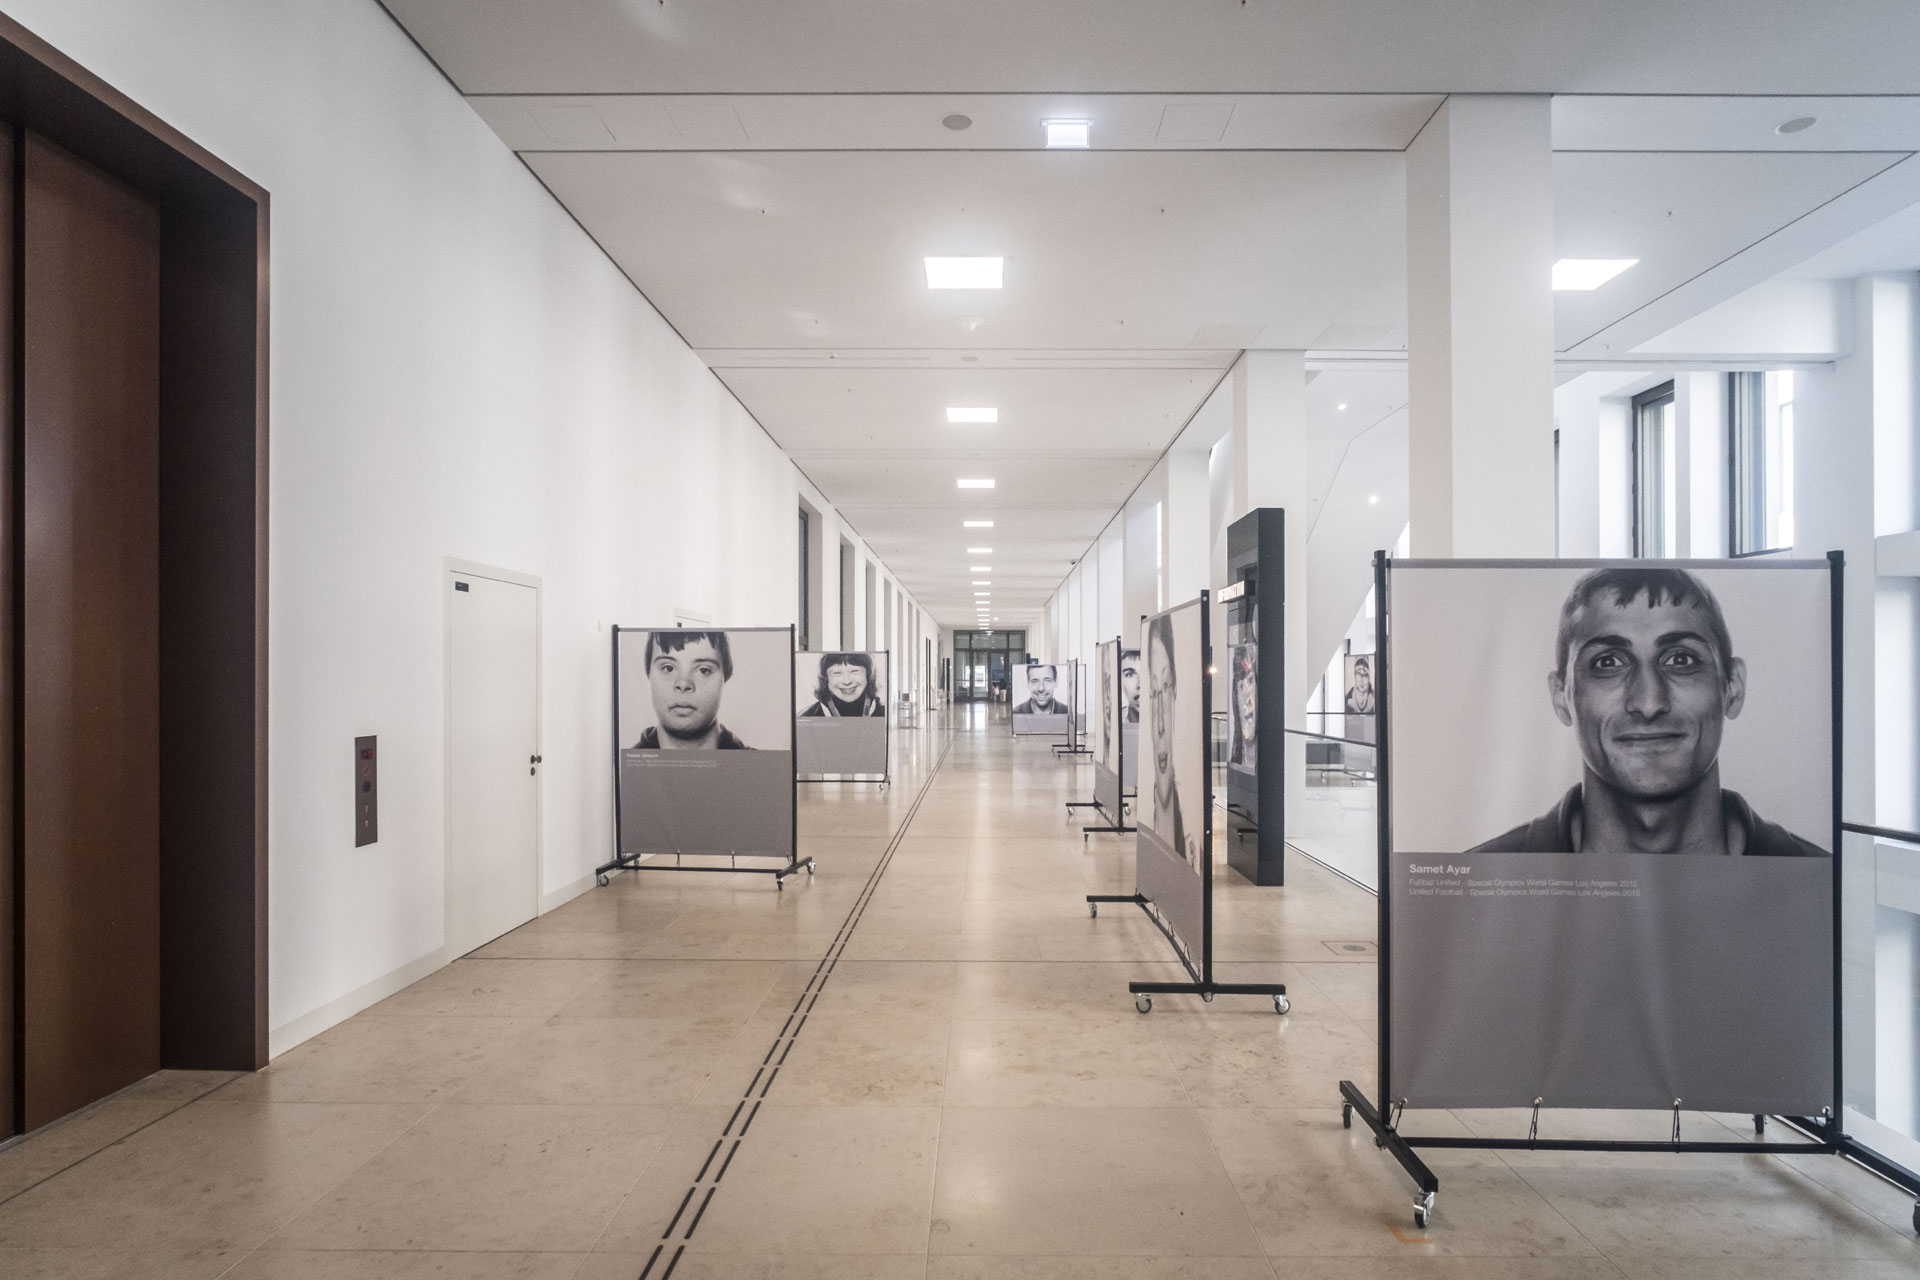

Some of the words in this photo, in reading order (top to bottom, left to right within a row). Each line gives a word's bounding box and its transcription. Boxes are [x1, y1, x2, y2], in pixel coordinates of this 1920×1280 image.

[1409, 864, 1444, 874] Samet
[1446, 864, 1472, 876] Ayar
[1493, 879, 1525, 887] Olympics
[1526, 879, 1547, 887] World
